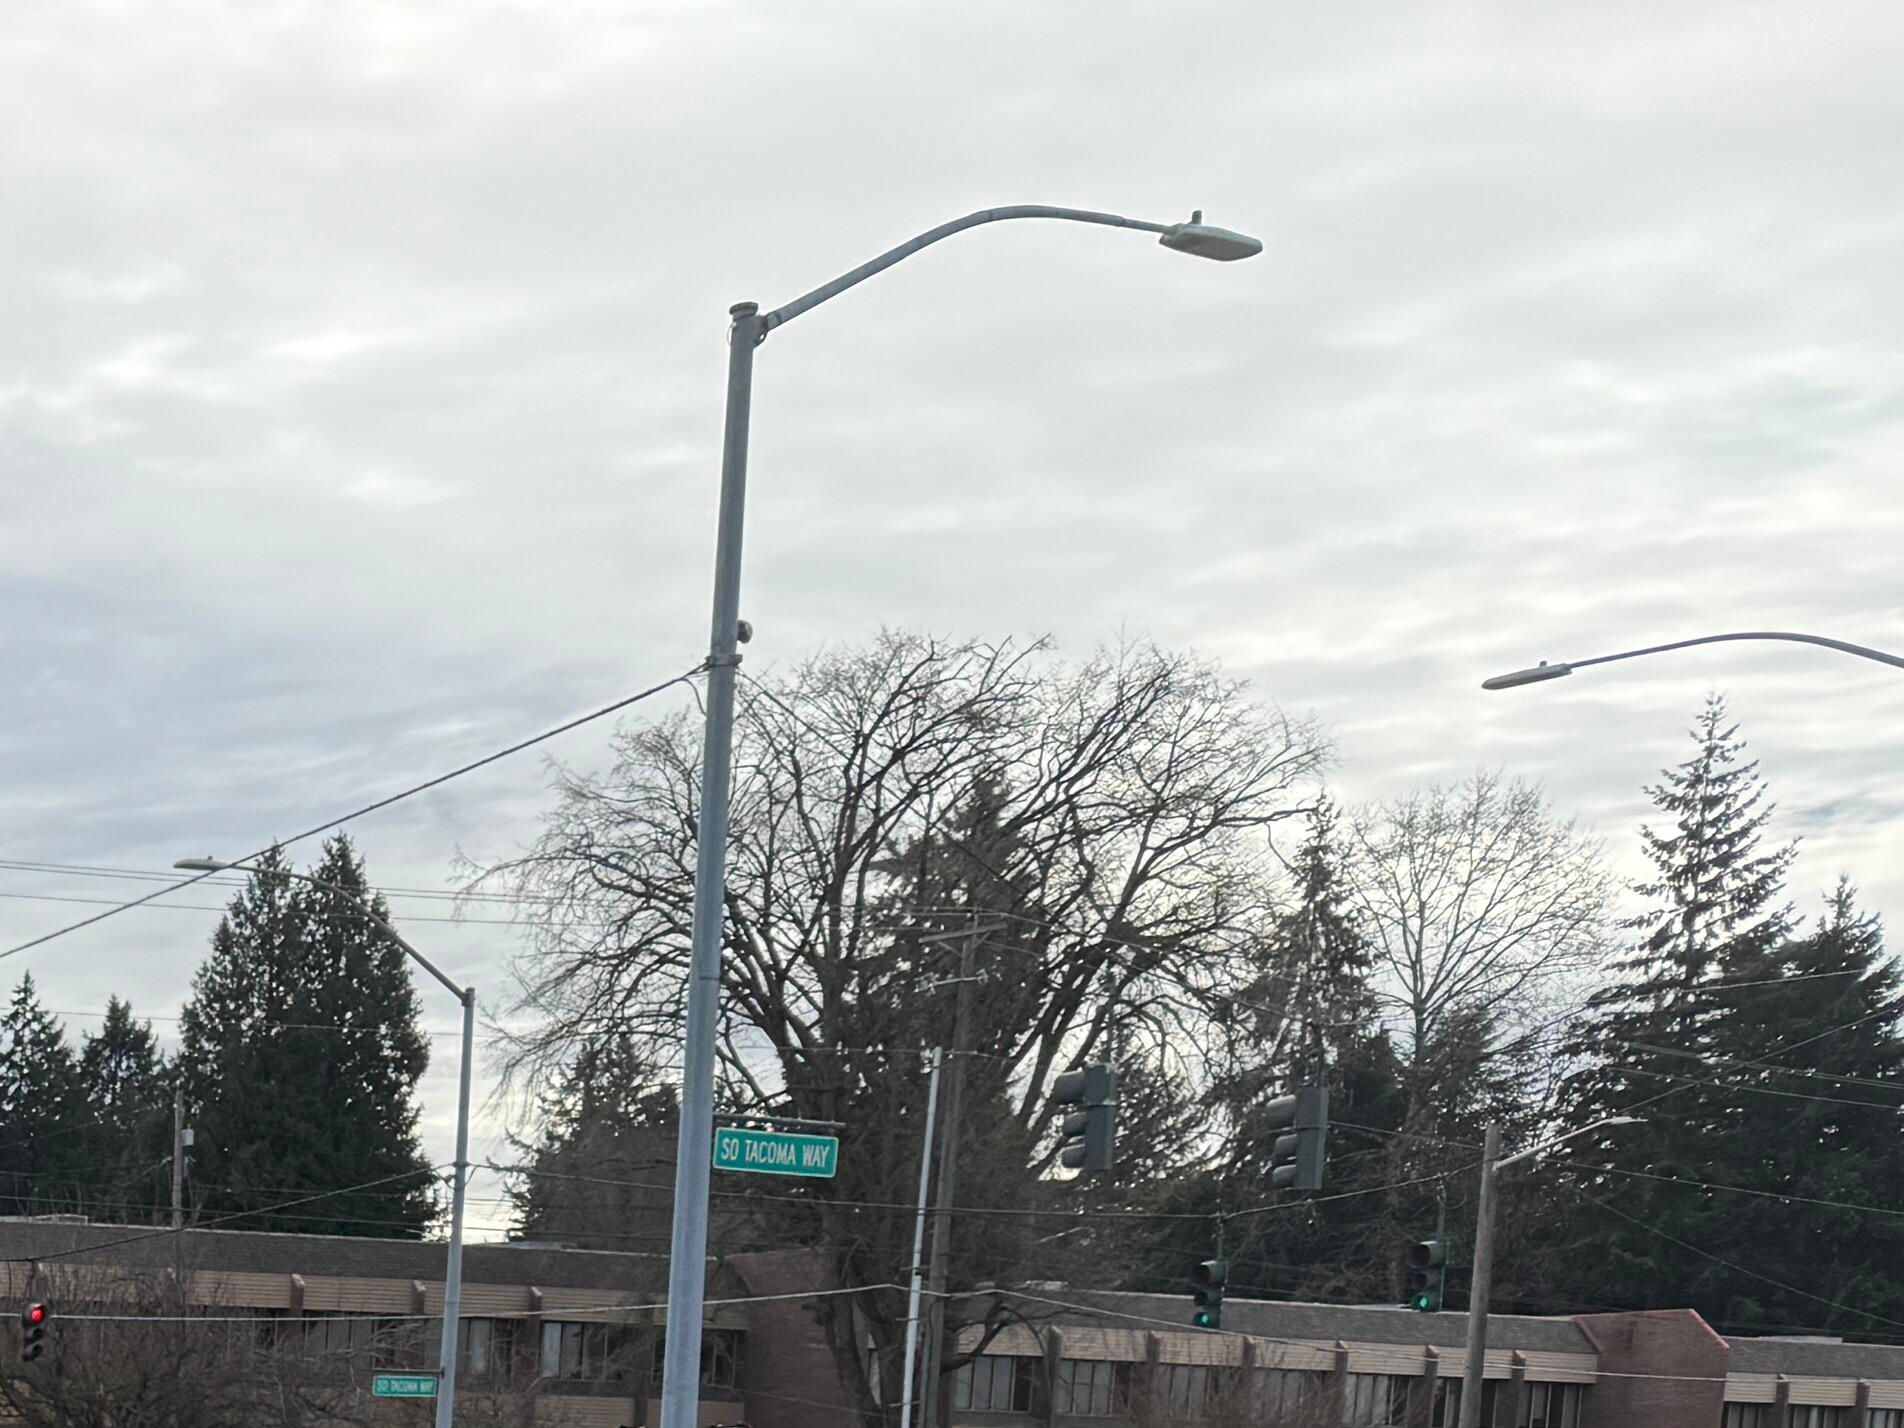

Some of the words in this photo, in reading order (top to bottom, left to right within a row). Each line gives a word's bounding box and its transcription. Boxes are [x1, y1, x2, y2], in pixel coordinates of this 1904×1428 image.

[720, 1137, 739, 1160] SO
[745, 1140, 796, 1165] TACOMA
[802, 1144, 830, 1168] WAY
